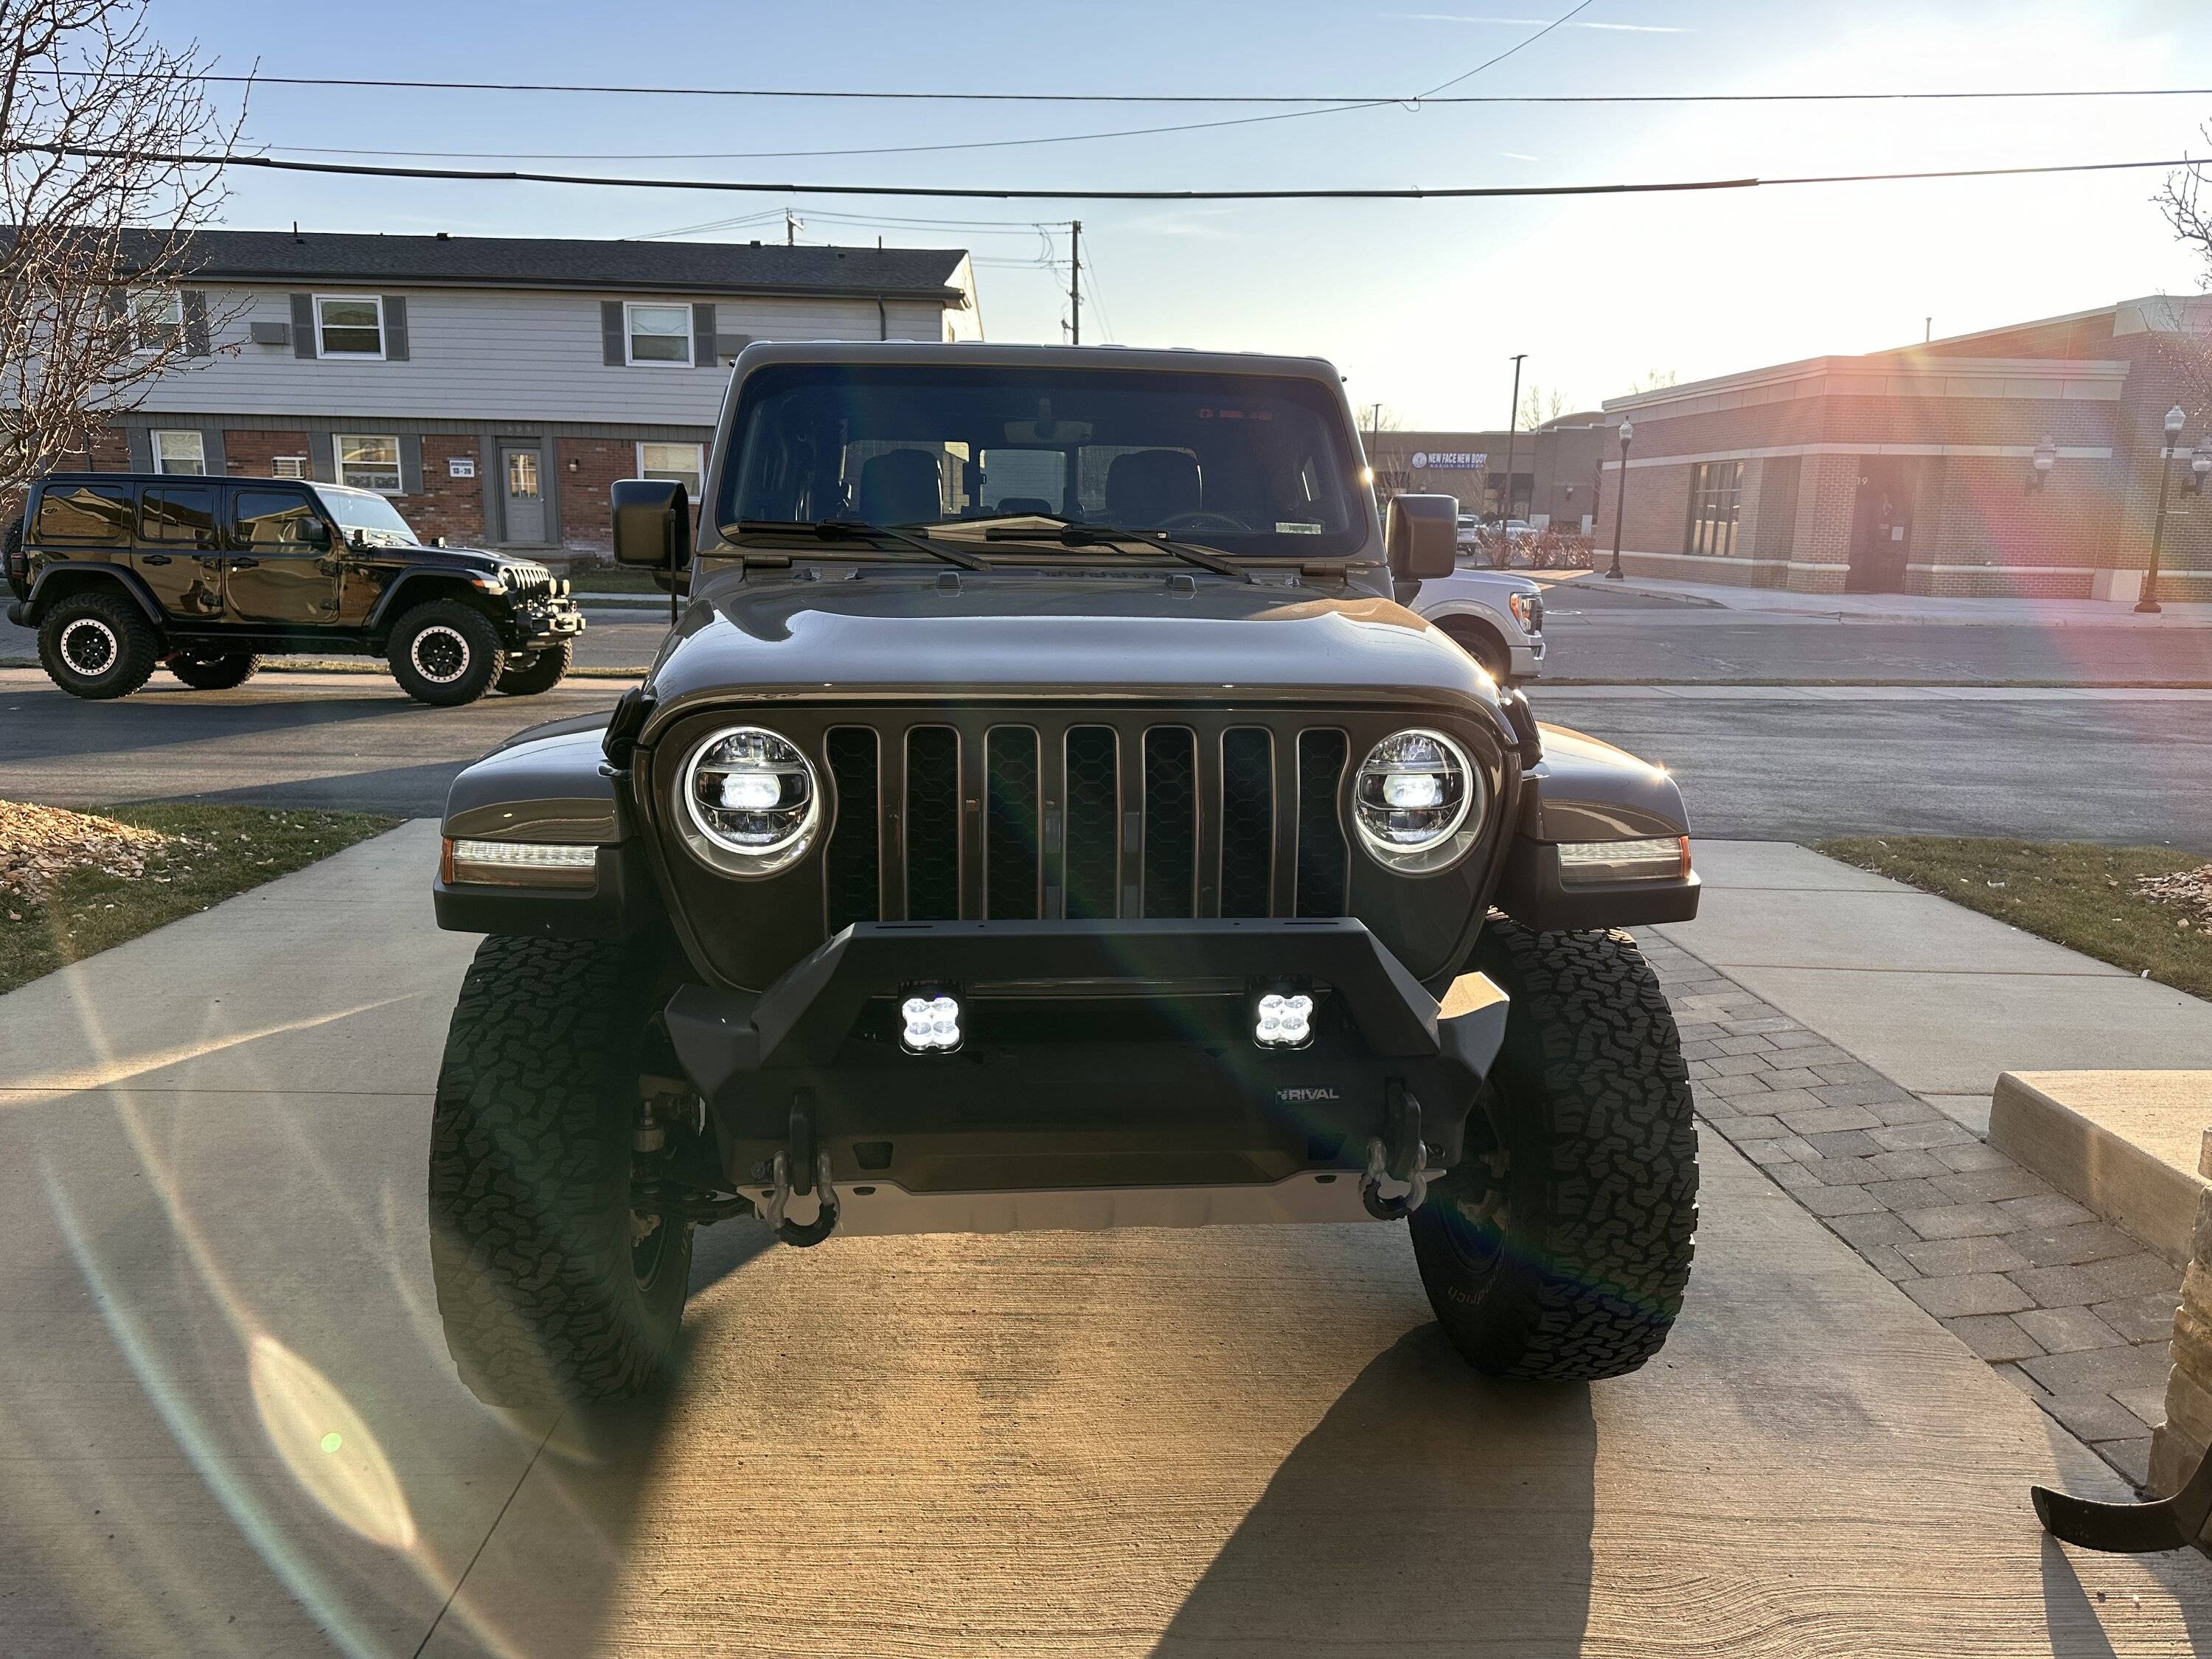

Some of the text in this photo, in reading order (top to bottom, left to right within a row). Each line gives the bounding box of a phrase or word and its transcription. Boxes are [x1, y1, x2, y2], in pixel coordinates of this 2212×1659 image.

[1428, 453, 1487, 463] NEW FACE NEW BODY
[1288, 1088, 1340, 1100] RIVAL
